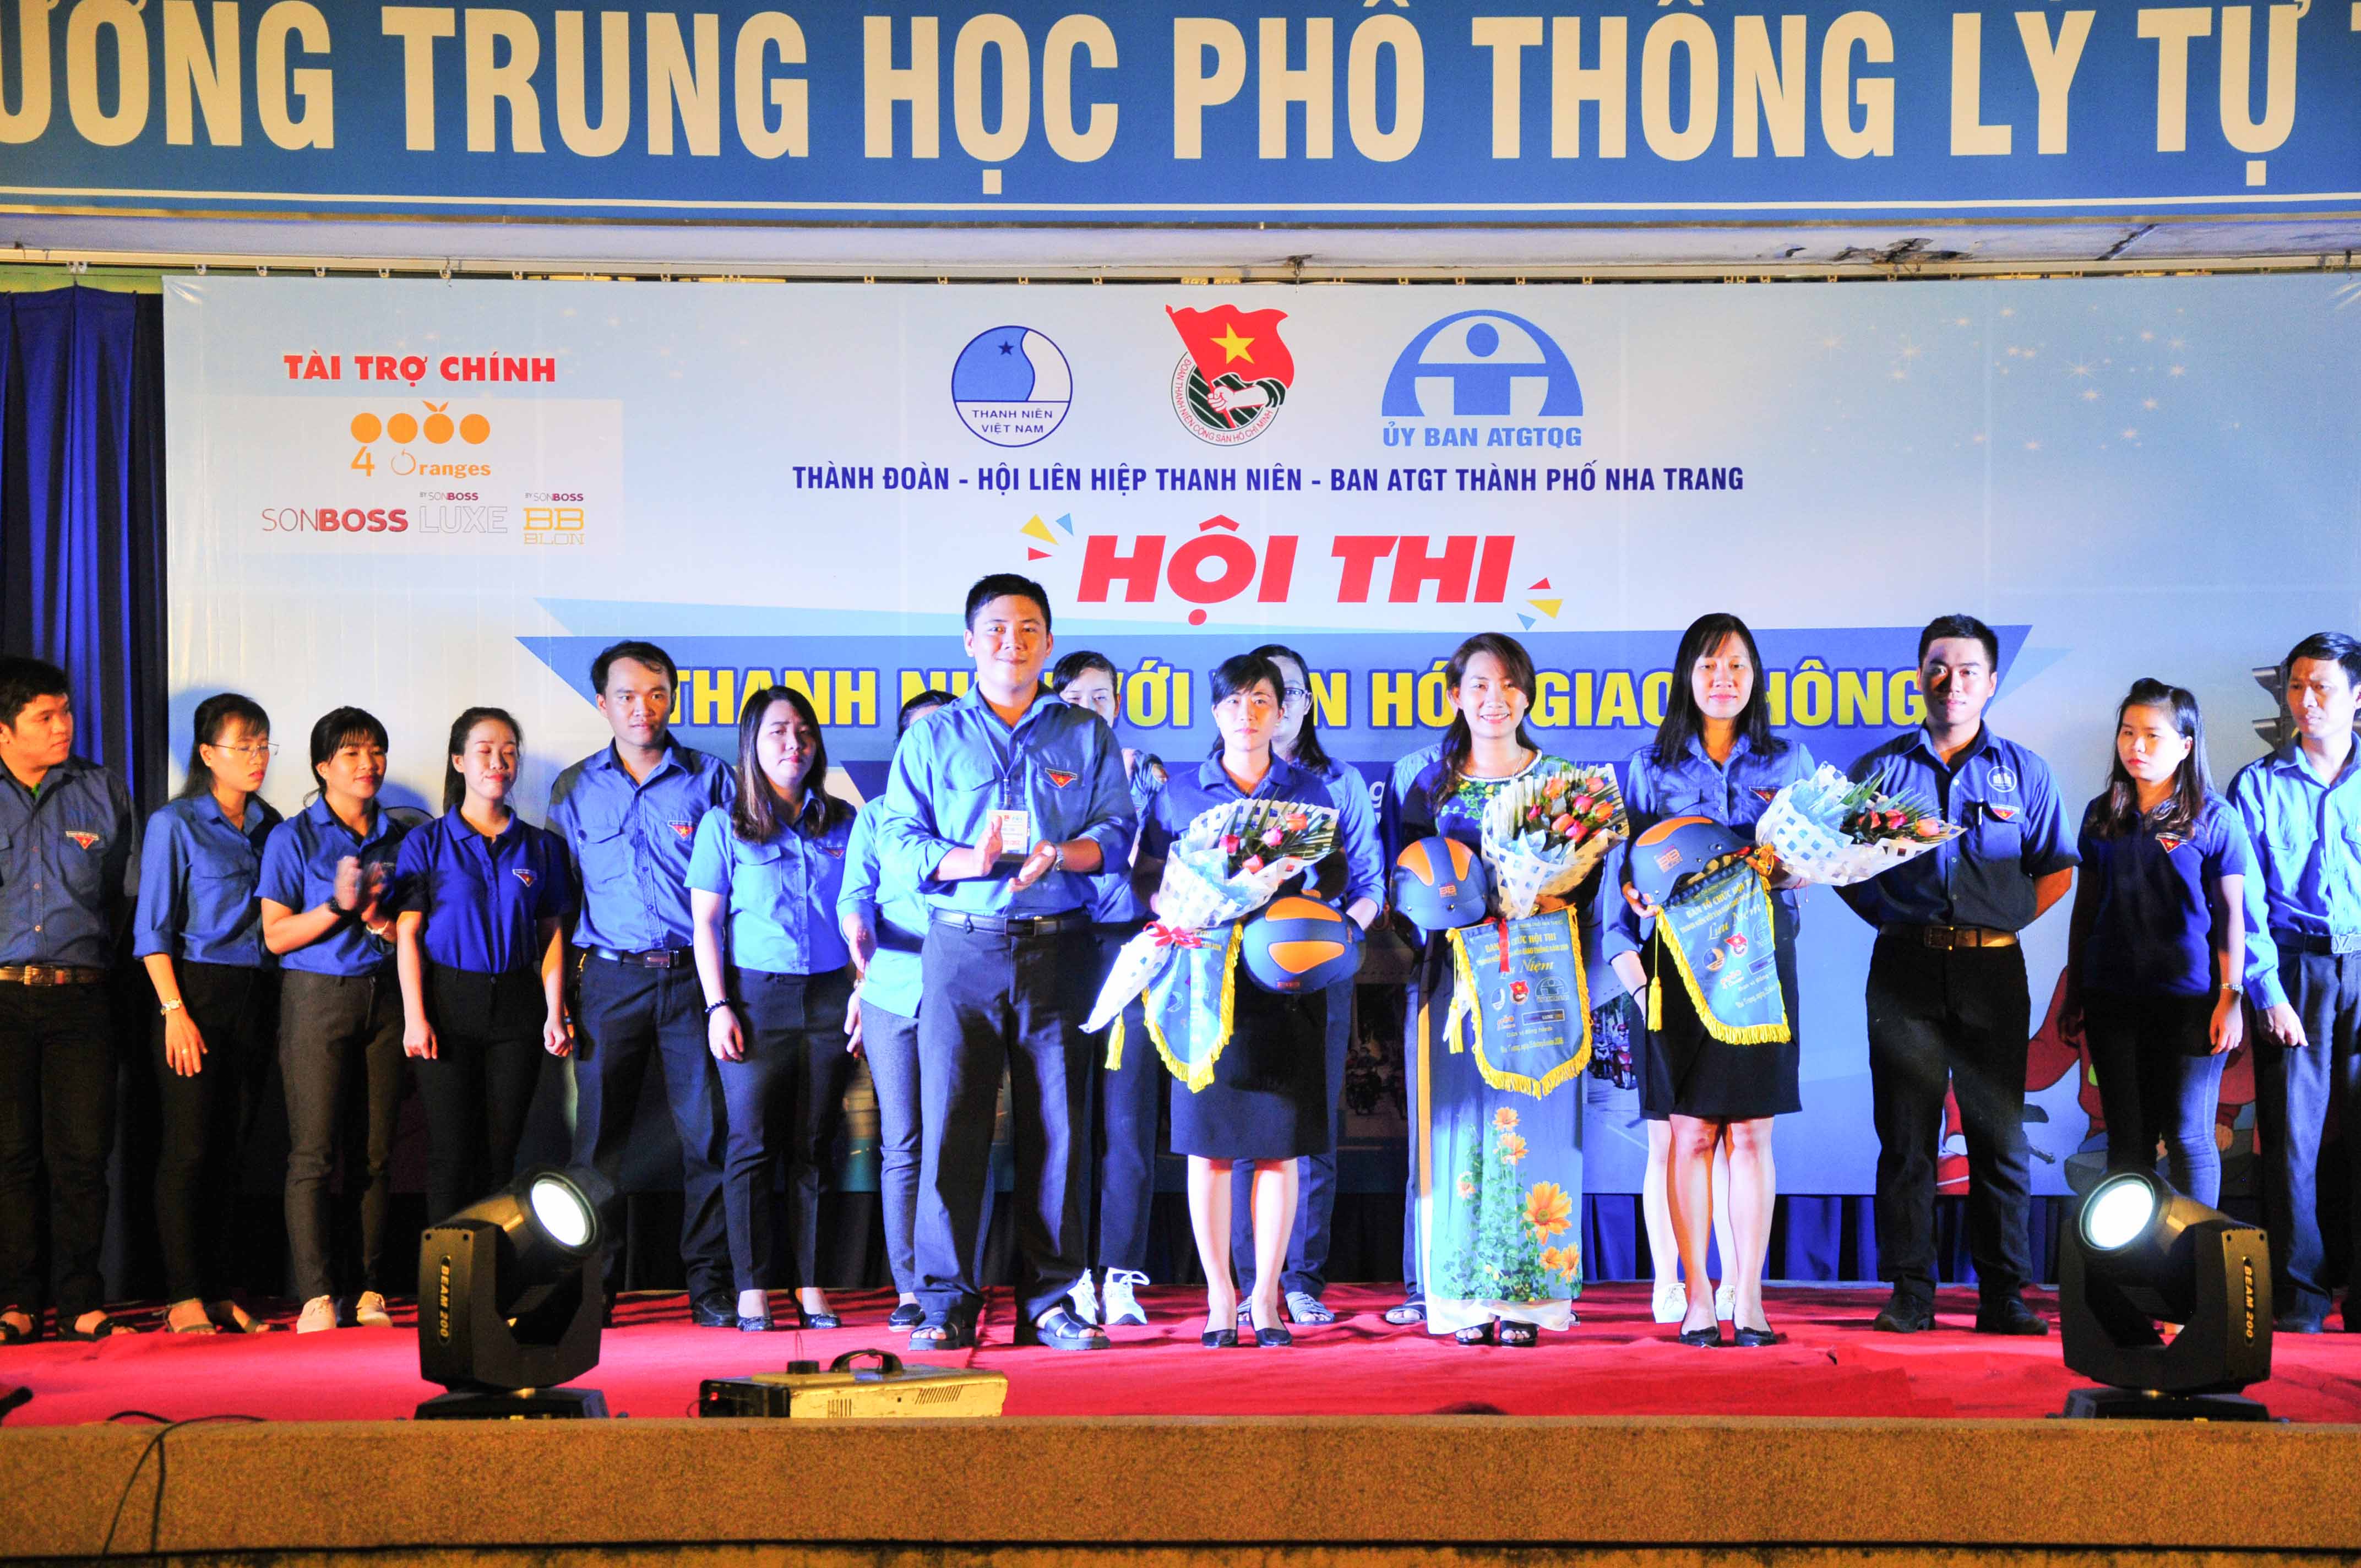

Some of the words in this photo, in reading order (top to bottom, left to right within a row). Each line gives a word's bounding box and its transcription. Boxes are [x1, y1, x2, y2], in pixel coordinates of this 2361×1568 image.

[382, 7, 808, 159] TRUNG
[864, 14, 1118, 193] HỌC
[1473, 0, 1894, 160] THÔNG
[284, 350, 341, 380] TÀI
[354, 356, 428, 388] TRỢ
[440, 352, 556, 382] CHÍNH
[972, 410, 1017, 418] THANH
[1021, 408, 1053, 418] NIÊN
[981, 423, 1010, 434] VIỆT
[1015, 424, 1044, 433] NAM
[1383, 421, 1416, 447] ỦY
[1424, 427, 1478, 447] BAN
[1487, 427, 1581, 449] ATGTQG
[351, 445, 375, 477] 4
[793, 461, 873, 489] THÀNH
[883, 462, 949, 489] ĐOÀN
[978, 462, 1019, 496] HỘI
[1030, 462, 1080, 490] LIÊN
[1092, 462, 1146, 496] HIỆP
[1155, 469, 1236, 491] THANH
[1247, 462, 1301, 491] NIÊN
[1331, 469, 1377, 491] BAN
[1387, 469, 1447, 491] ATGT
[1455, 463, 1536, 491] THÀNH
[1547, 460, 1597, 491] PHỐ
[1606, 468, 1655, 491] NHA
[1663, 467, 1743, 490] TRANG
[428, 492, 478, 500] SONBOSS
[262, 508, 409, 532] SONBOSS
[419, 506, 508, 533] LUXE
[523, 507, 584, 530] BB
[1078, 515, 1298, 625] HỘI
[1332, 535, 1515, 603] THI
[1116, 660, 1189, 726] ỚI
[1372, 661, 1456, 727] HÓ
[1529, 671, 1674, 727] GIAO
[440, 1265, 450, 1308] BEAM
[2244, 1266, 2254, 1308] BEAM
[440, 1310, 450, 1338] 200
[2246, 1310, 2254, 1339] 200
